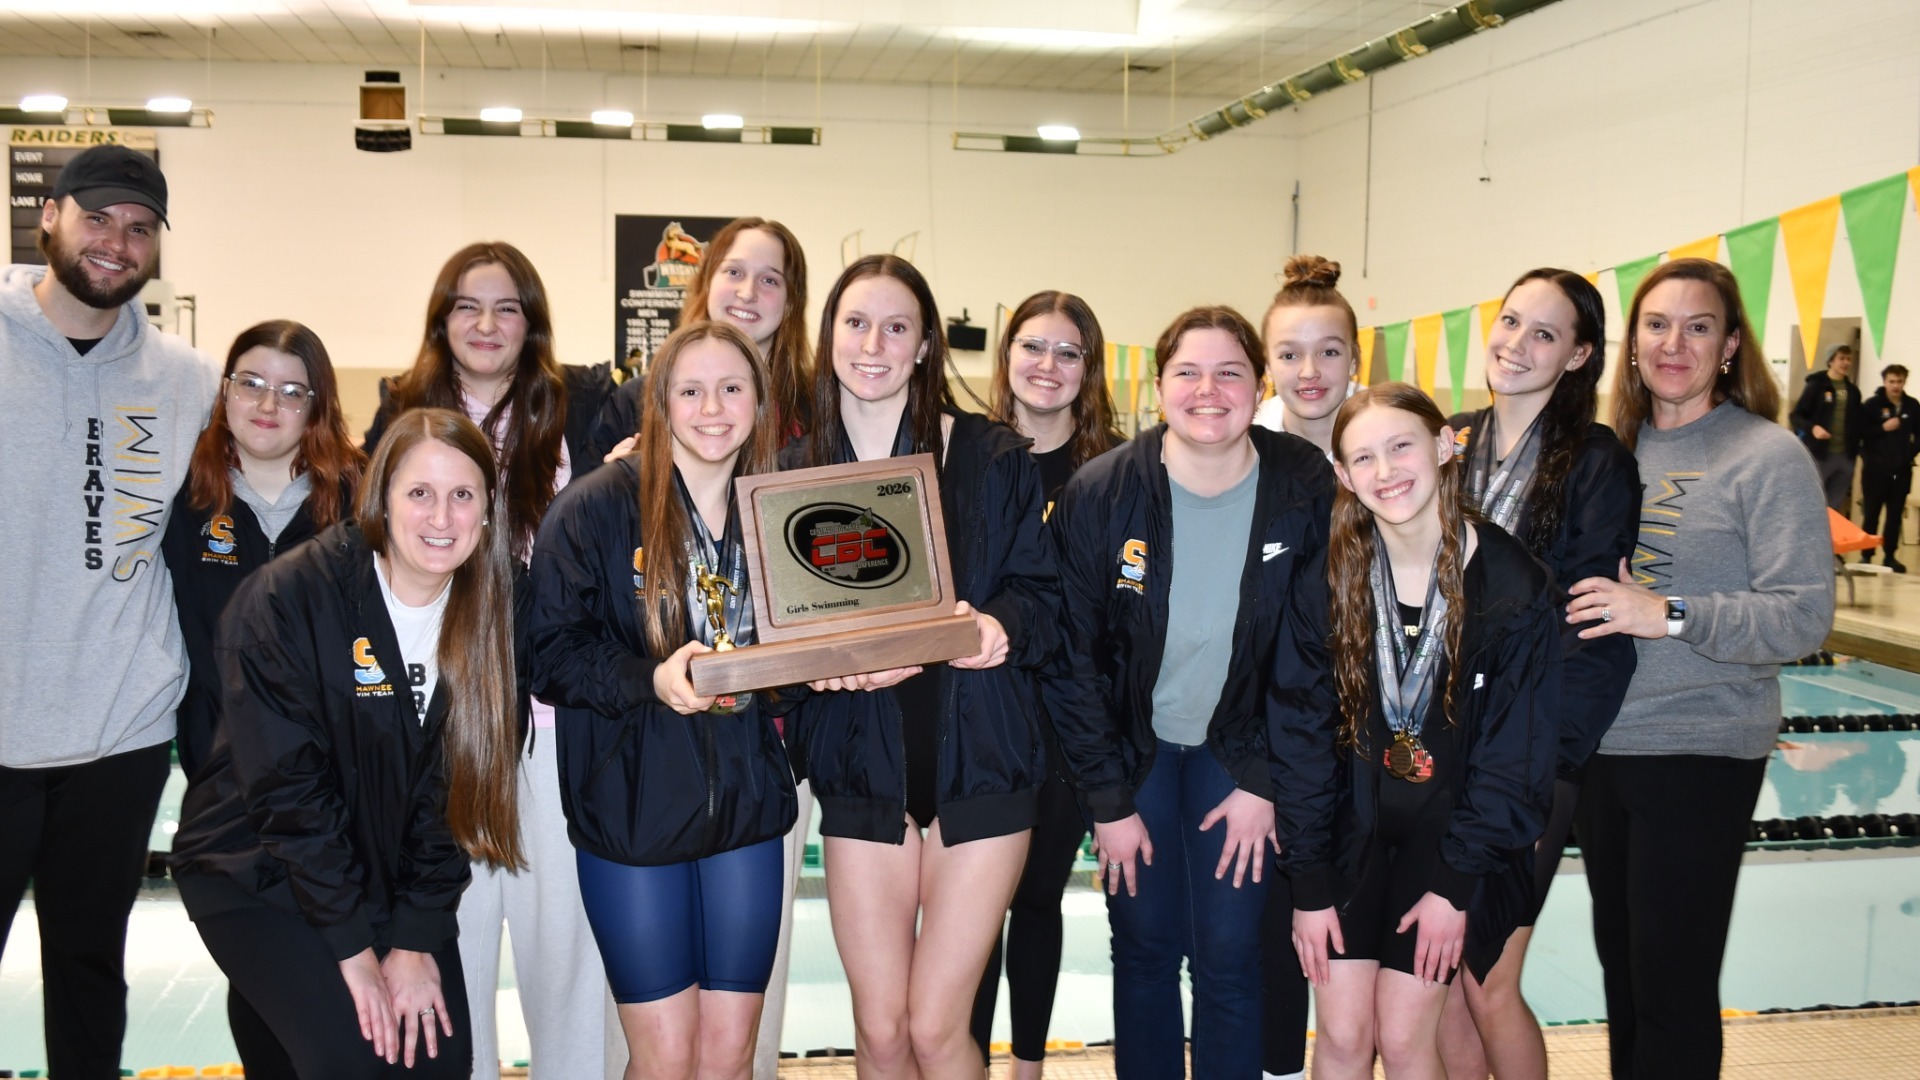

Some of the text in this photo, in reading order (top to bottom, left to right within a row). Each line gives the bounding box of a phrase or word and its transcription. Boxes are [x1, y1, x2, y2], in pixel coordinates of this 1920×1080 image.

[11, 128, 119, 143] RAIDERS
[15, 152, 43, 162] EVENT
[16, 172, 43, 183] HOME
[629, 290, 679, 299] SWIMMING
[638, 309, 658, 317] MEN
[83, 417, 104, 571] BRAVES
[876, 481, 912, 497] 2026
[812, 527, 888, 567] CBC
[202, 552, 238, 561] SHAWNEE
[853, 558, 889, 569] CONFERENCE
[786, 597, 861, 615] Girls Swimming
